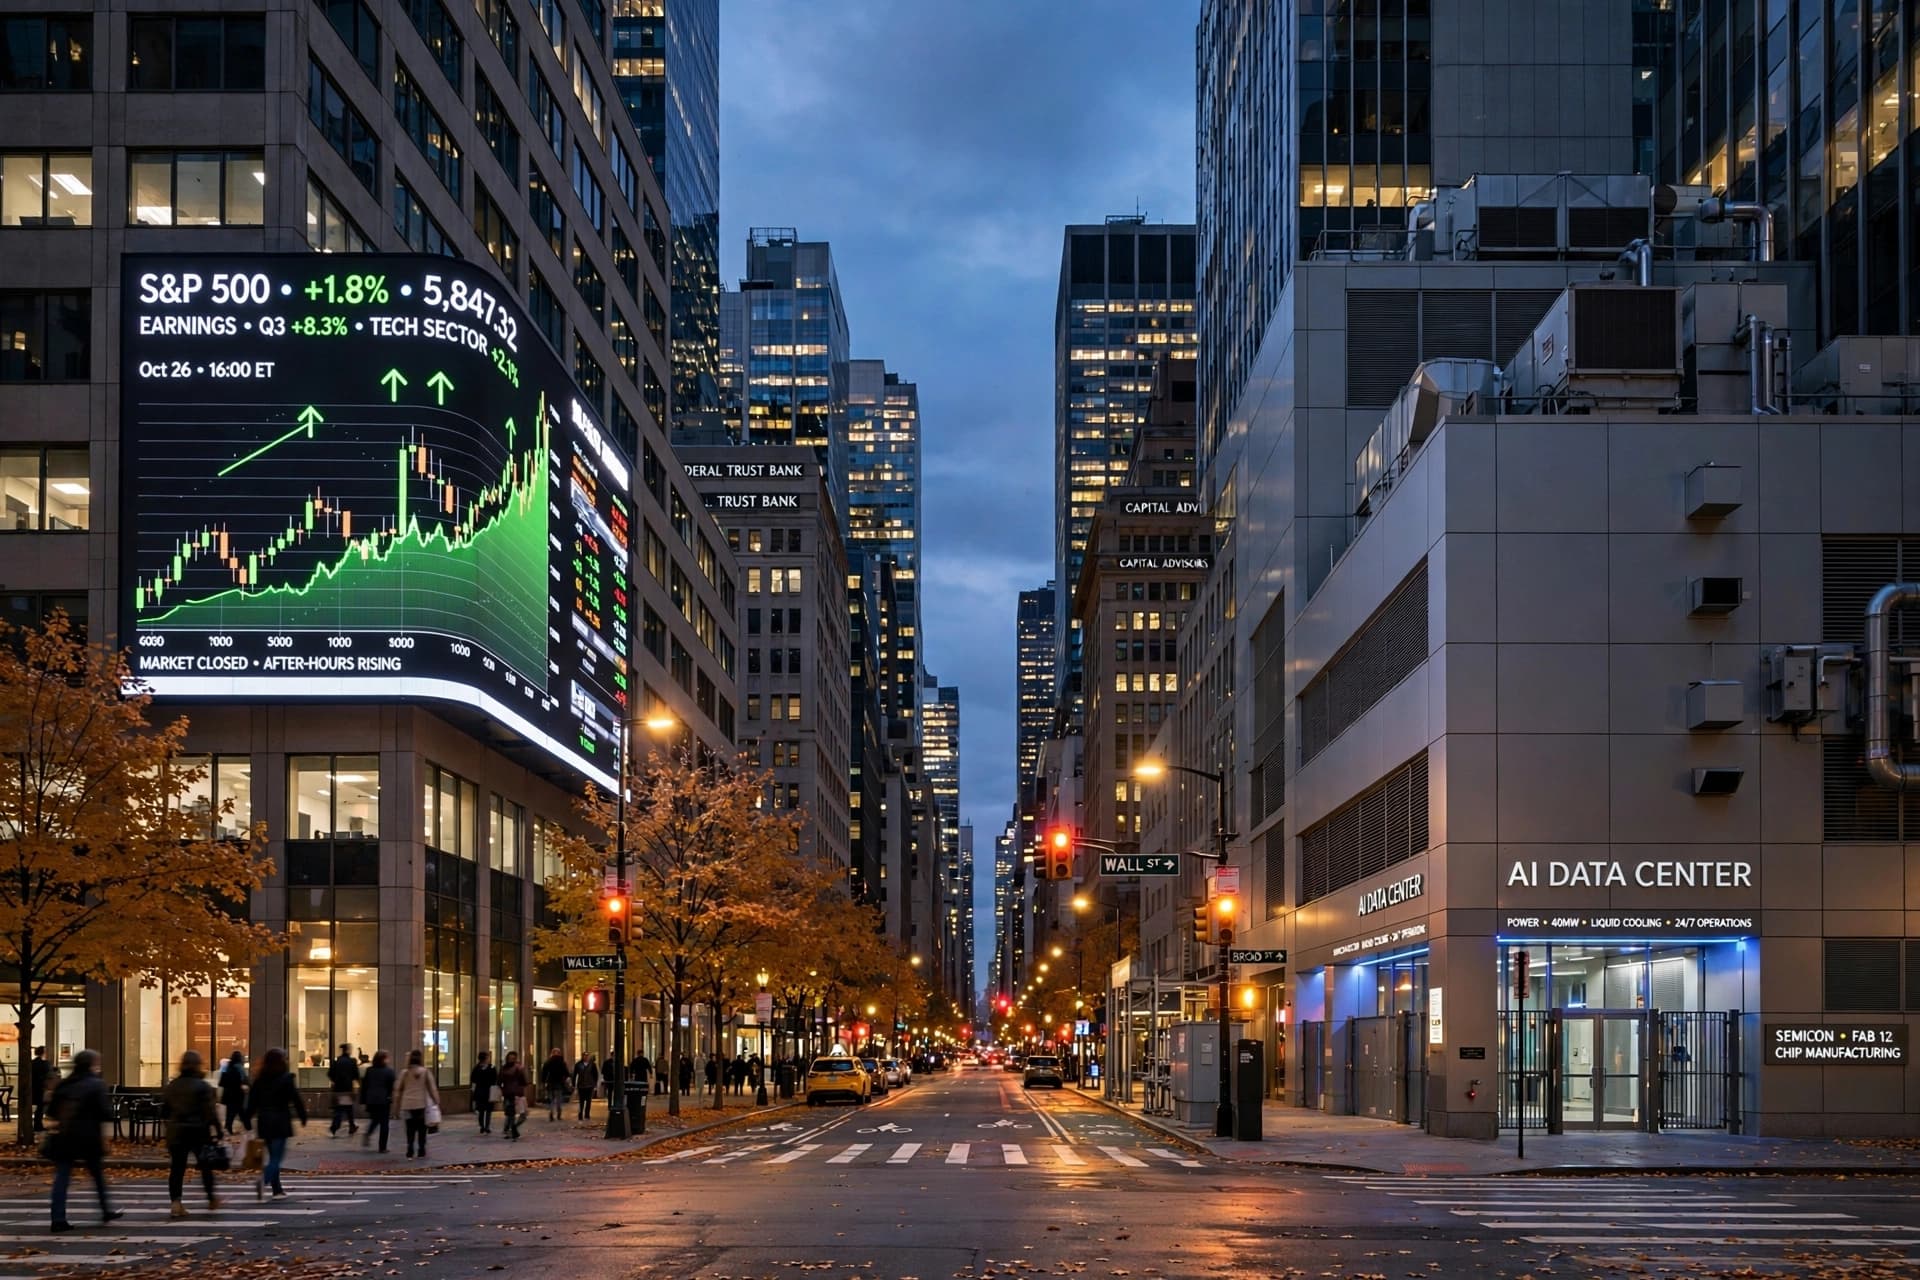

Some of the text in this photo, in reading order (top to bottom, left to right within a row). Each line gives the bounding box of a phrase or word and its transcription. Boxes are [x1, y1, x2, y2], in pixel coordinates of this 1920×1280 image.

[140, 273, 518, 353] S&P 500 +1.8% 5,847.32
[140, 316, 237, 335] EARNINGS
[258, 316, 286, 337] Q3
[291, 316, 348, 336] +8.3%
[370, 316, 418, 336] TECH
[423, 320, 488, 356] SECTOR
[139, 361, 275, 377] Oct 26 16:00 ET
[726, 465, 765, 477] TRUST
[769, 465, 802, 476] BANK
[717, 496, 757, 507] TRUST
[762, 496, 798, 507] BANK
[1125, 503, 1171, 513] CAPITAL
[1119, 559, 1159, 568] CAPITAL
[327, 636, 352, 648] 1000
[140, 656, 402, 671] MARKET CLOSED AFTER-HOURS RISING
[1105, 858, 1161, 872] WALL ST
[1507, 861, 1752, 887] AI DATA CENTER
[1367, 888, 1387, 914] DATA
[1388, 874, 1421, 906] CENTER
[1507, 918, 1752, 929] POWER 40MW LIQUID COOLING 24/7 OPERATIONS
[567, 957, 594, 968] WALL
[1775, 1030, 1893, 1043] SEMICON FAB 12
[1775, 1047, 1901, 1059] CHIP MANUFACTURING
